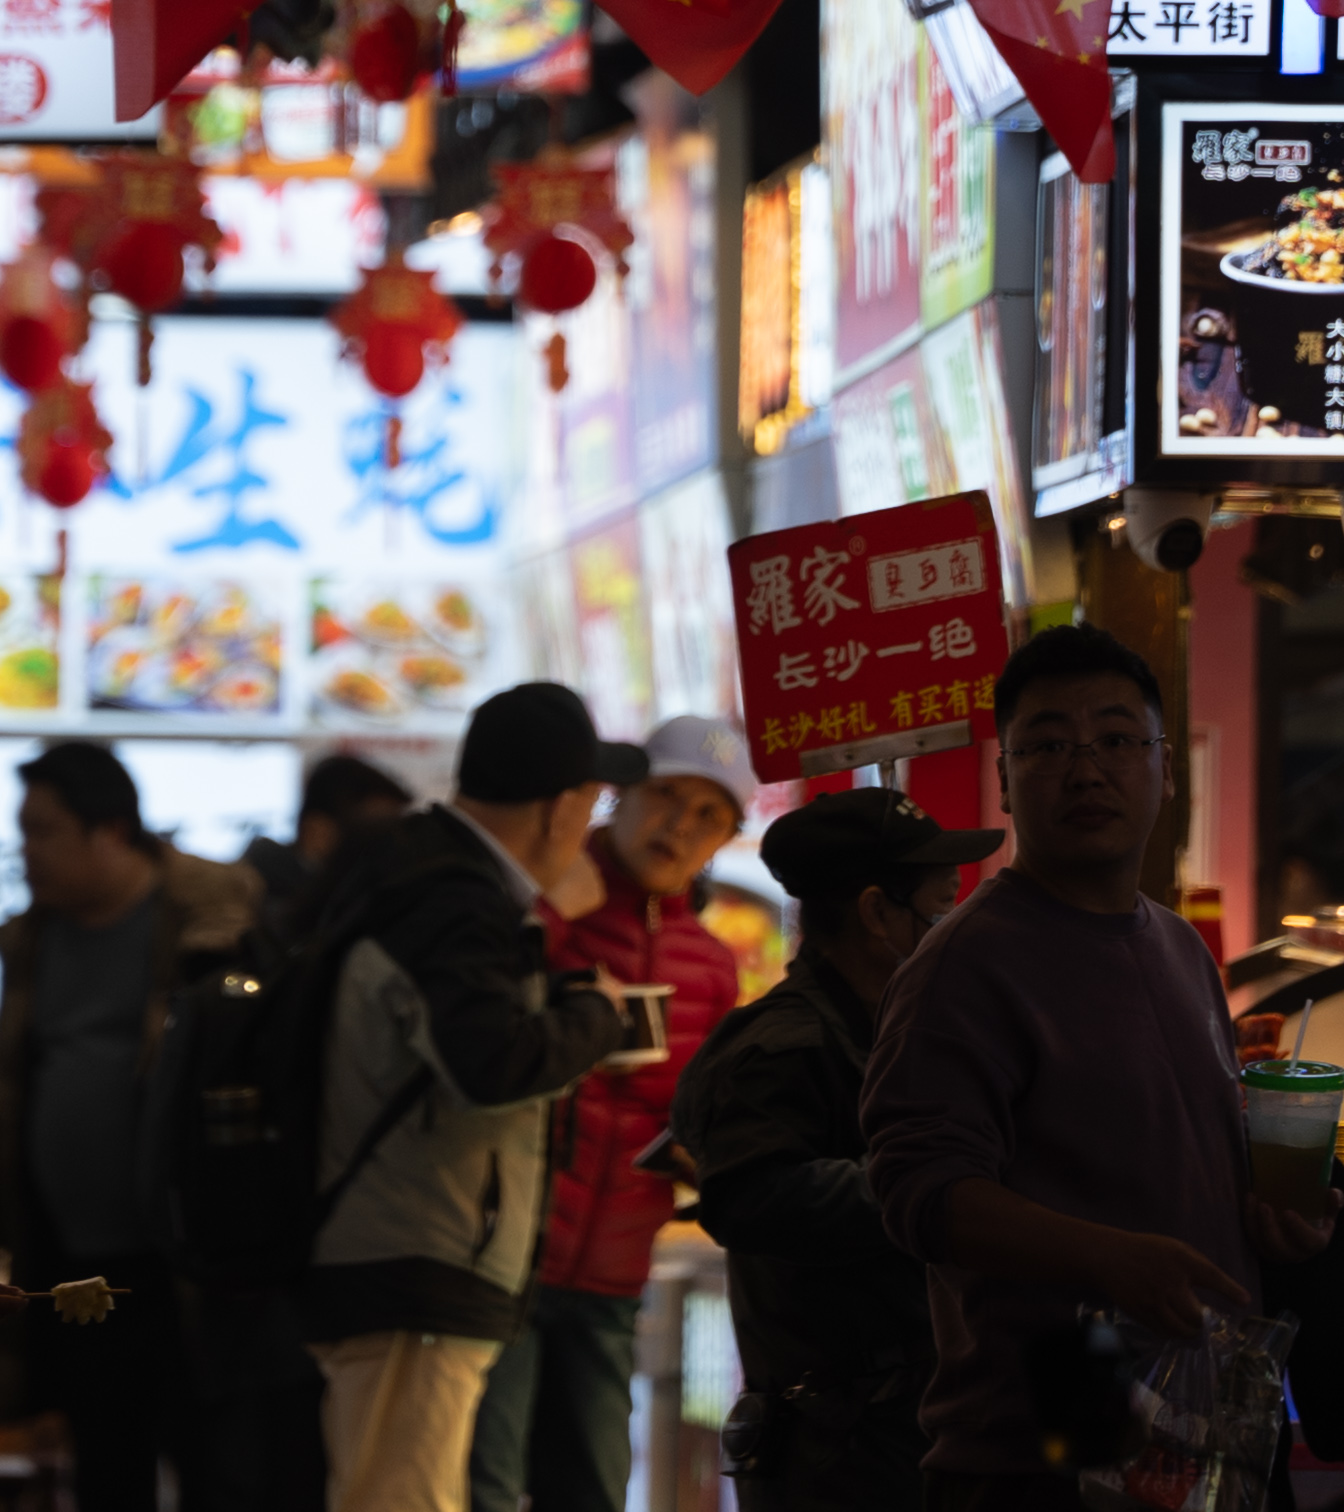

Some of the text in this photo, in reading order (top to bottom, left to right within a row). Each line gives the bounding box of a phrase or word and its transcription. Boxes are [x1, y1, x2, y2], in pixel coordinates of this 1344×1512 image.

[1108, 1, 1254, 44] 太平街
[746, 545, 974, 636] 羅家 臭豆腐
[774, 617, 977, 690] 长沙一绝
[761, 701, 877, 754] 长沙好礼
